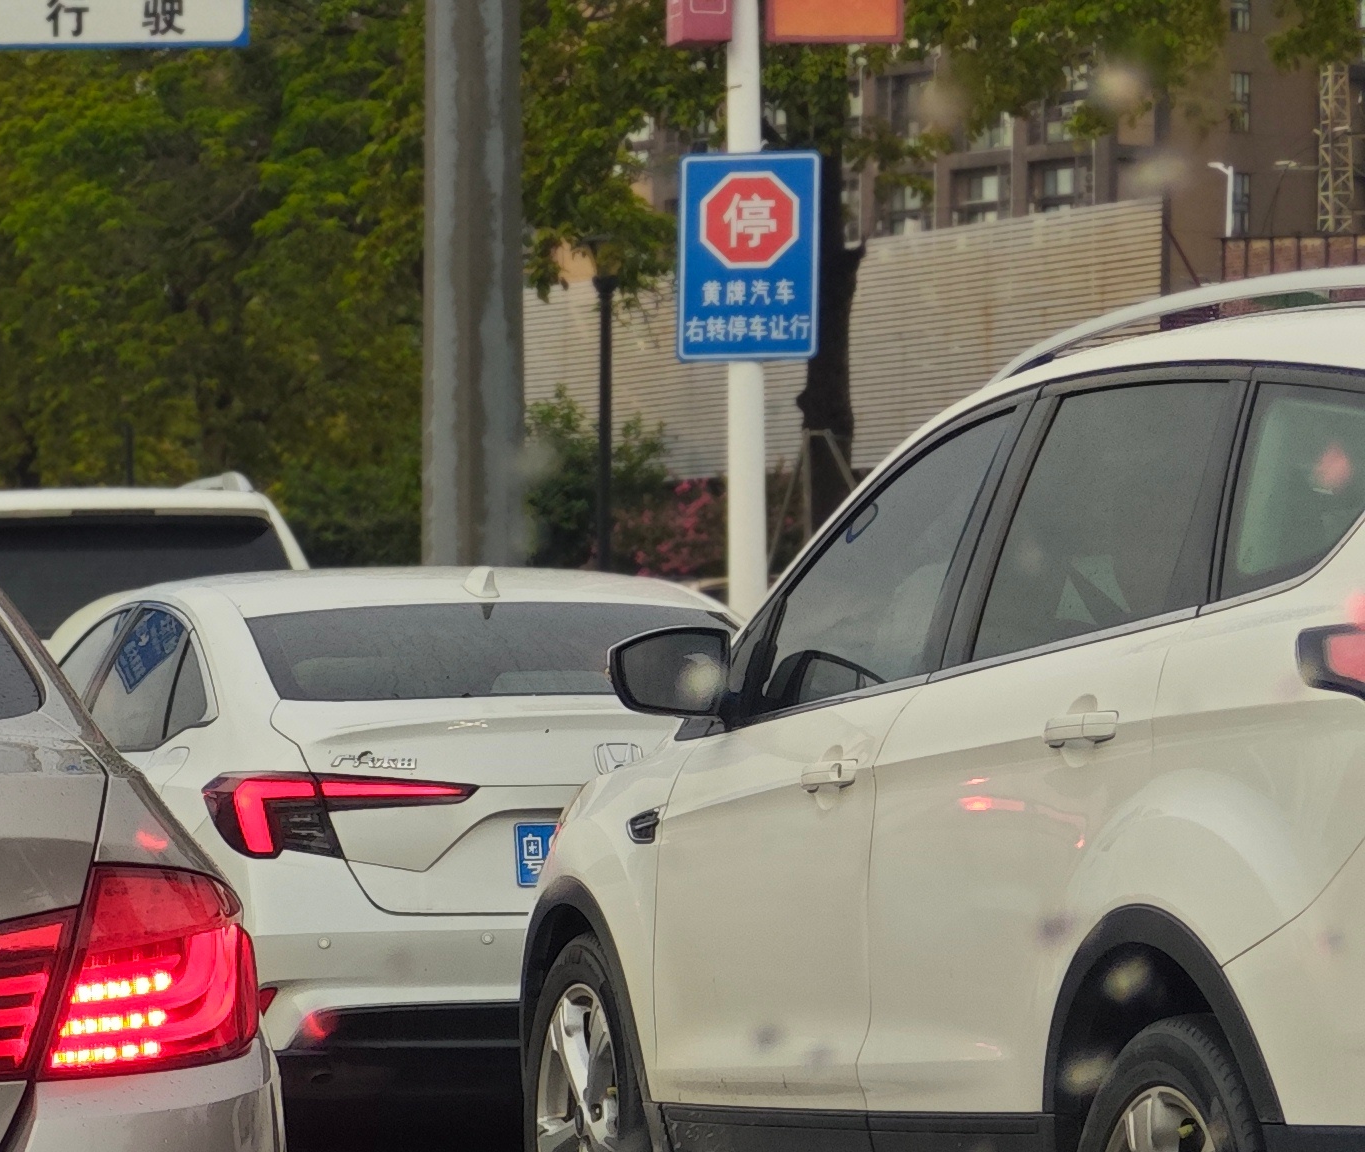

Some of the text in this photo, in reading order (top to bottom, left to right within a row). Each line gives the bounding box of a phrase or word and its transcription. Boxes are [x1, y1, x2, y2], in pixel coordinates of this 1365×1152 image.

[722, 192, 778, 248] 停
[702, 278, 796, 306] 黄牌汽车
[685, 314, 810, 342] 右转停车让行
